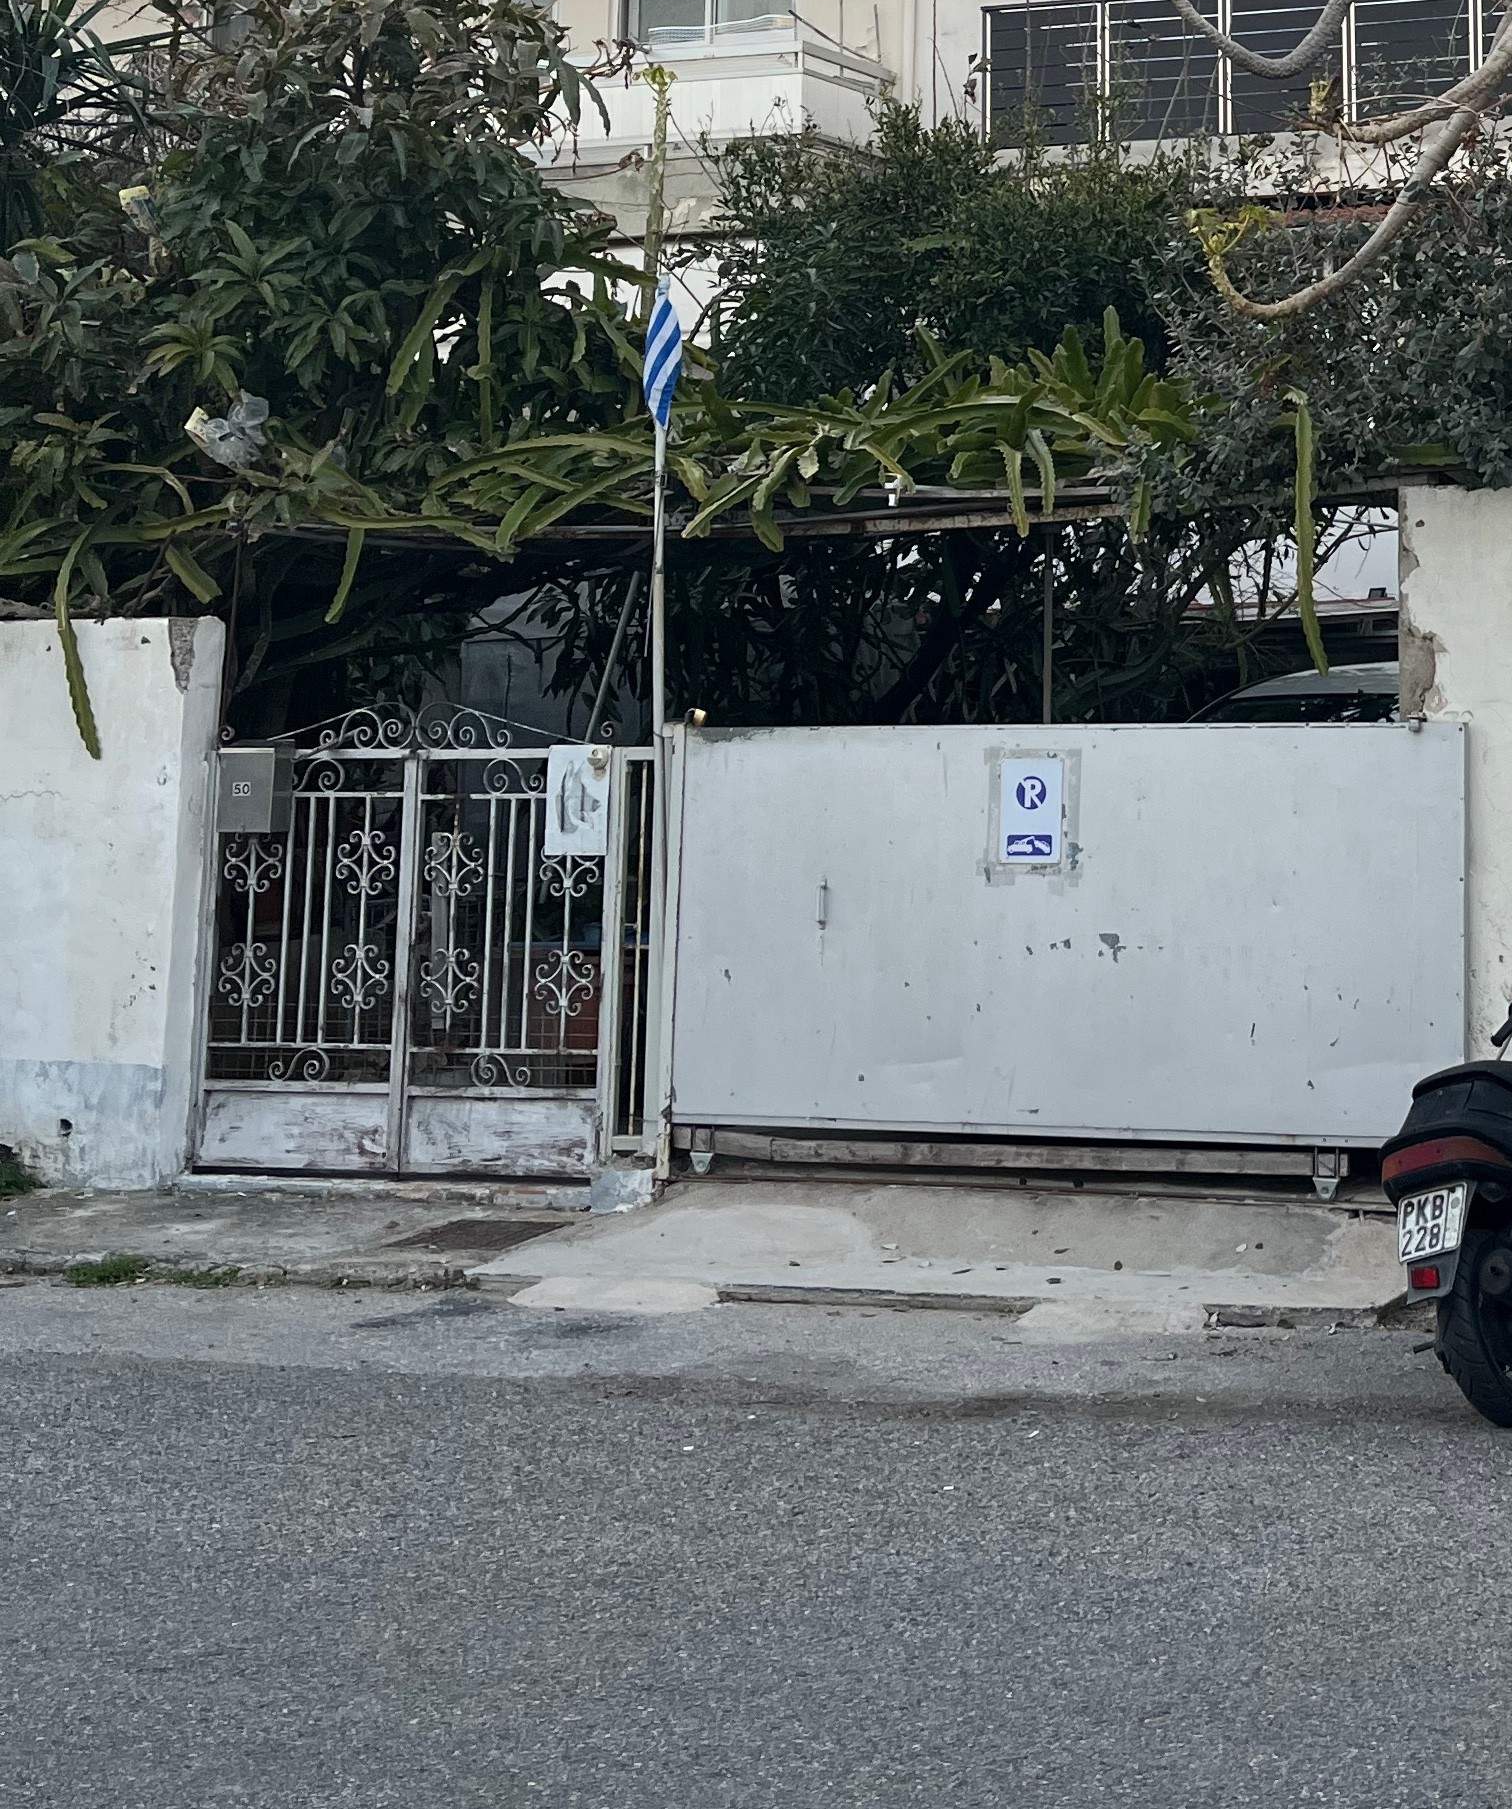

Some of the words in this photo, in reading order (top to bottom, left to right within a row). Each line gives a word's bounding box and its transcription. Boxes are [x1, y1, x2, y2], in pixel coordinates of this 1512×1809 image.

[234, 783, 250, 795] 50
[1402, 1194, 1445, 1230] PKB
[1401, 1223, 1441, 1258] 228
